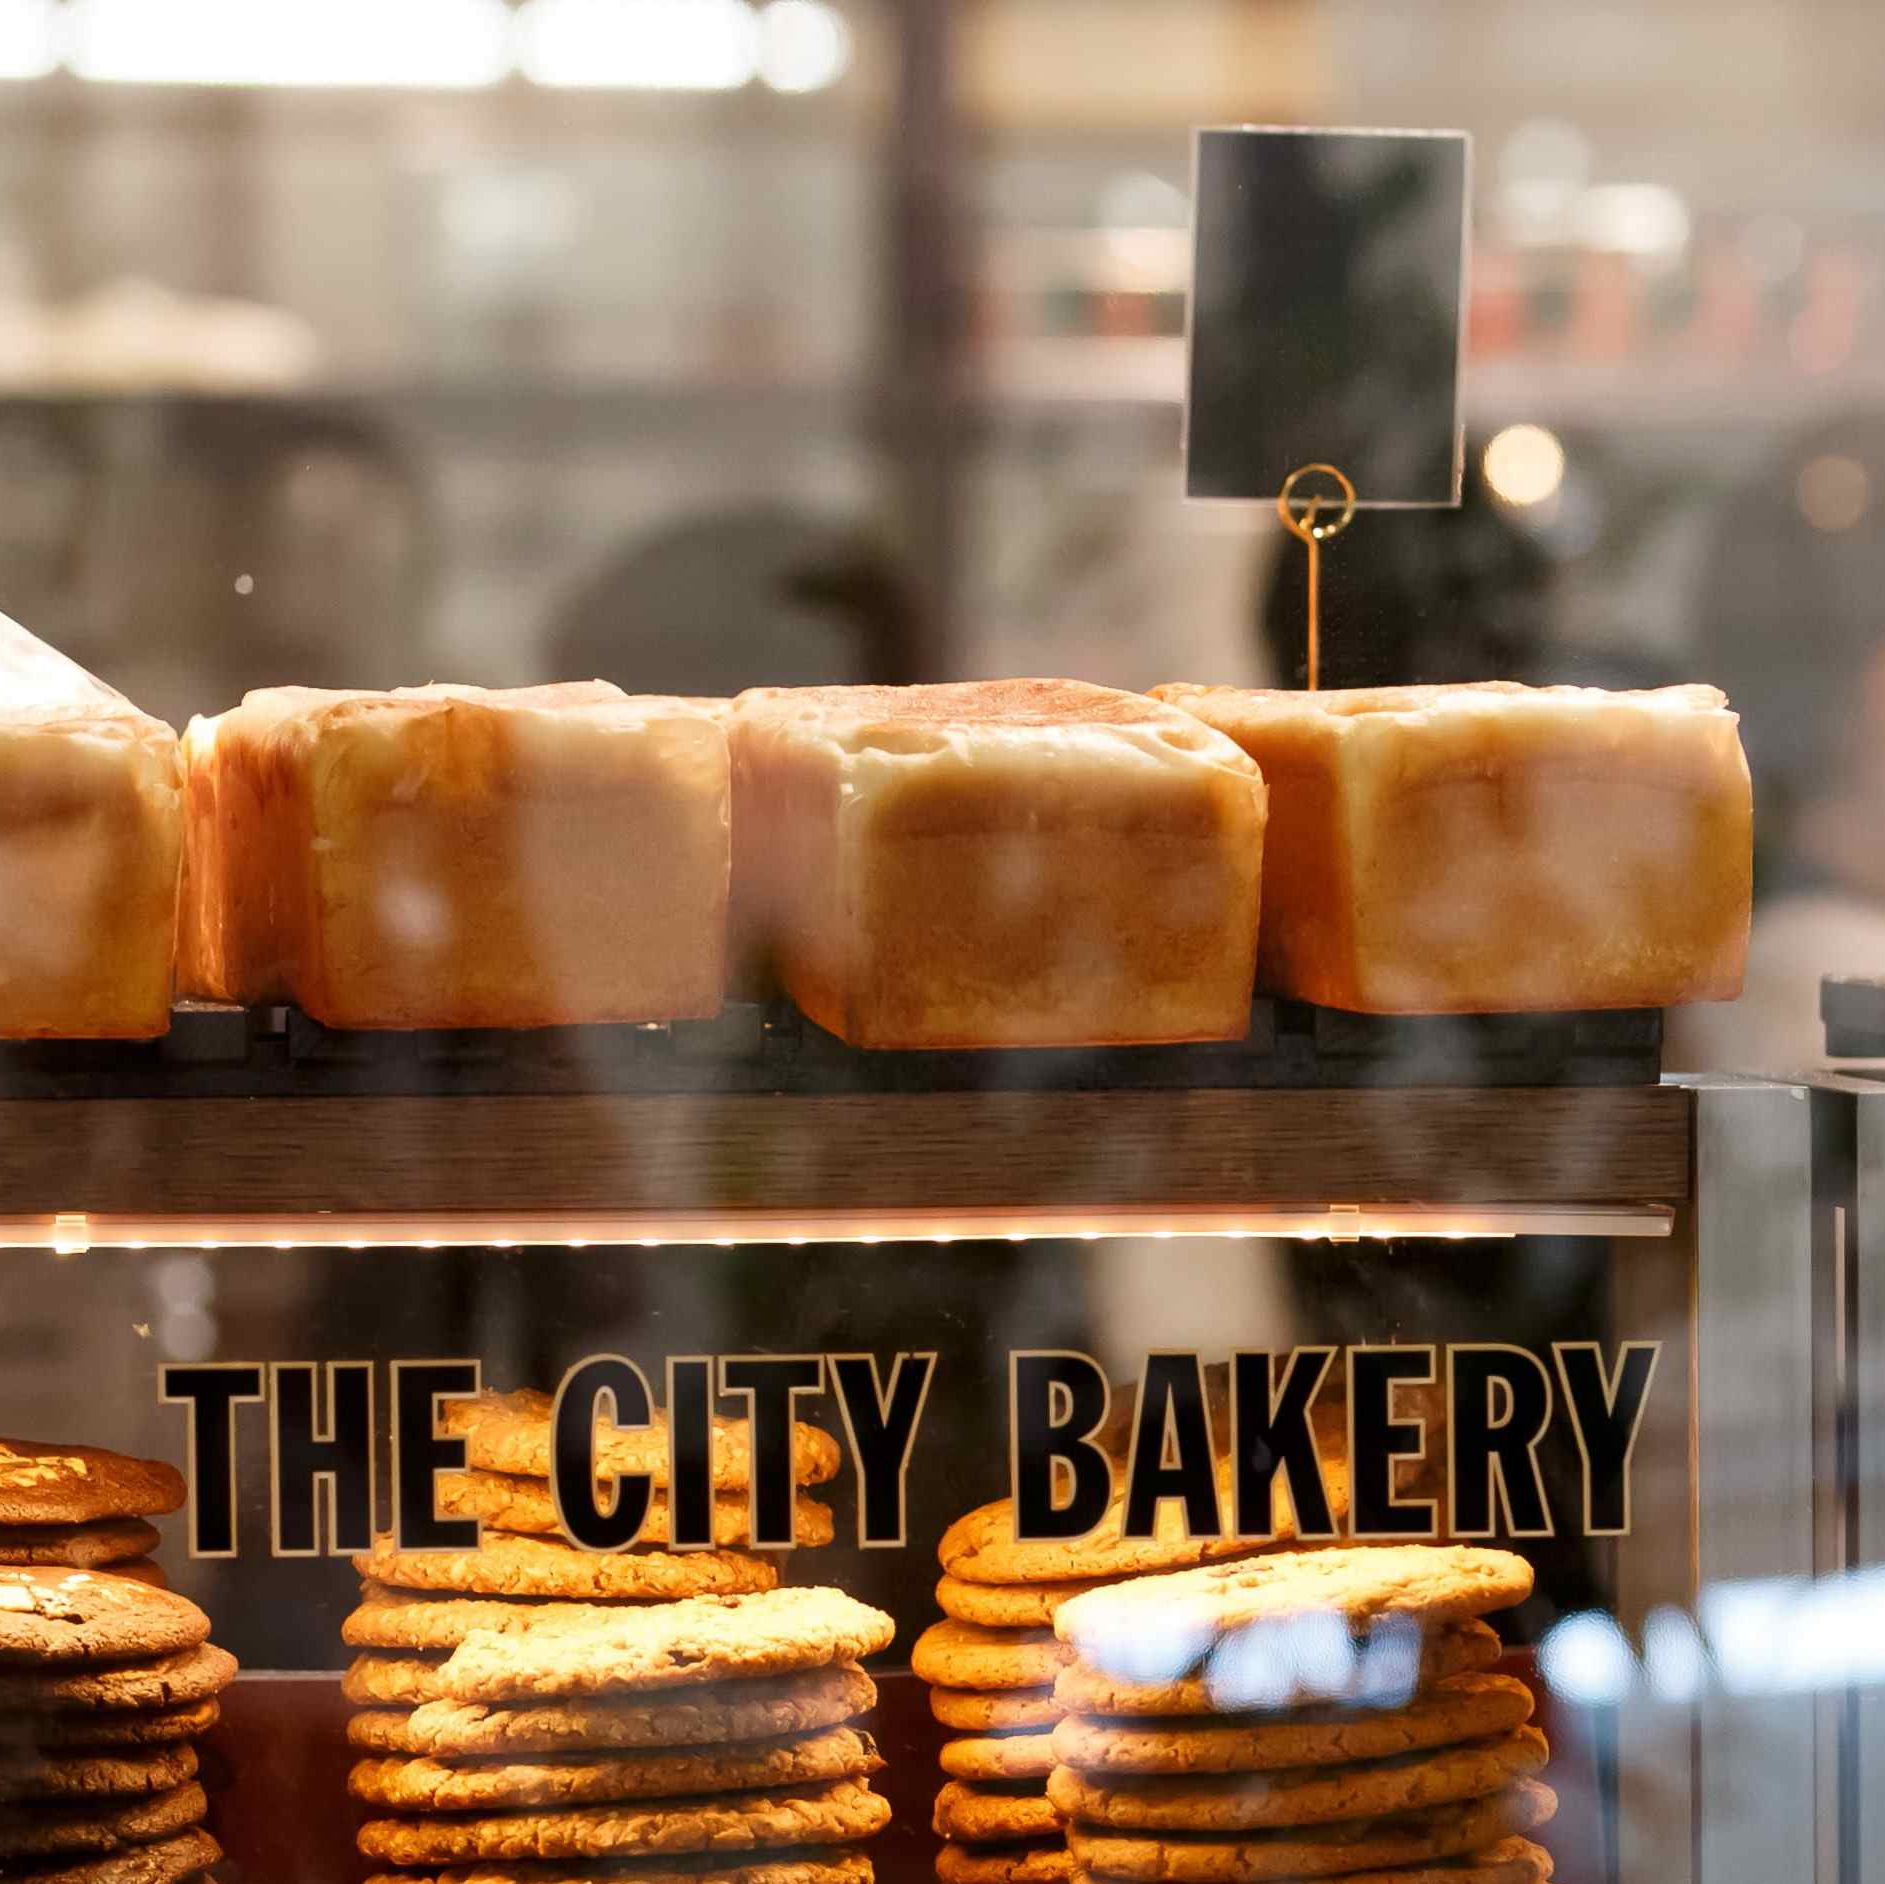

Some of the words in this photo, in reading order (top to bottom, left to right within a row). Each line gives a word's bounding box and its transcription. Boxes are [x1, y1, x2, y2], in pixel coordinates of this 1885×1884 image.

[158, 1358, 482, 1558] THE
[549, 1351, 936, 1551] CITY
[1008, 1341, 1663, 1544] BAKERY
